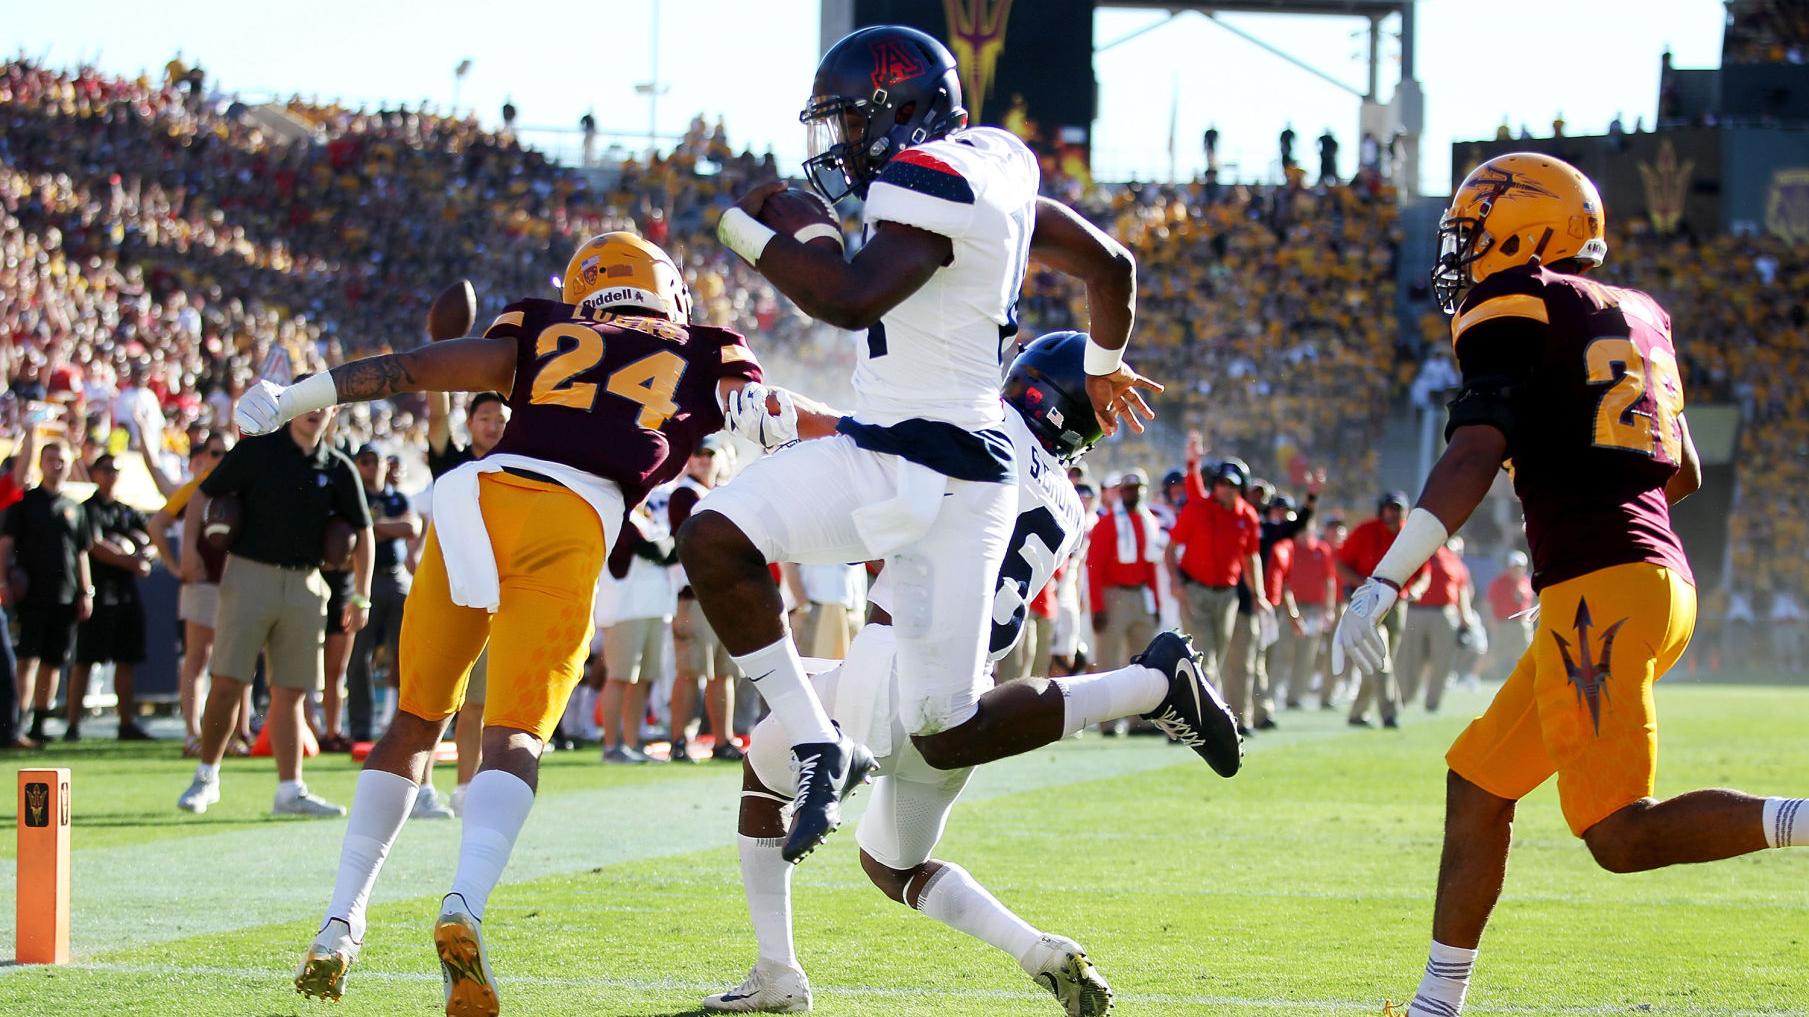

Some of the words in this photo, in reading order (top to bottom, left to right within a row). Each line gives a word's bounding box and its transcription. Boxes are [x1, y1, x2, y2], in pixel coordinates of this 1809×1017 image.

[582, 288, 632, 309] Riddell
[530, 322, 689, 431] 24
[988, 505, 1066, 654] 6
